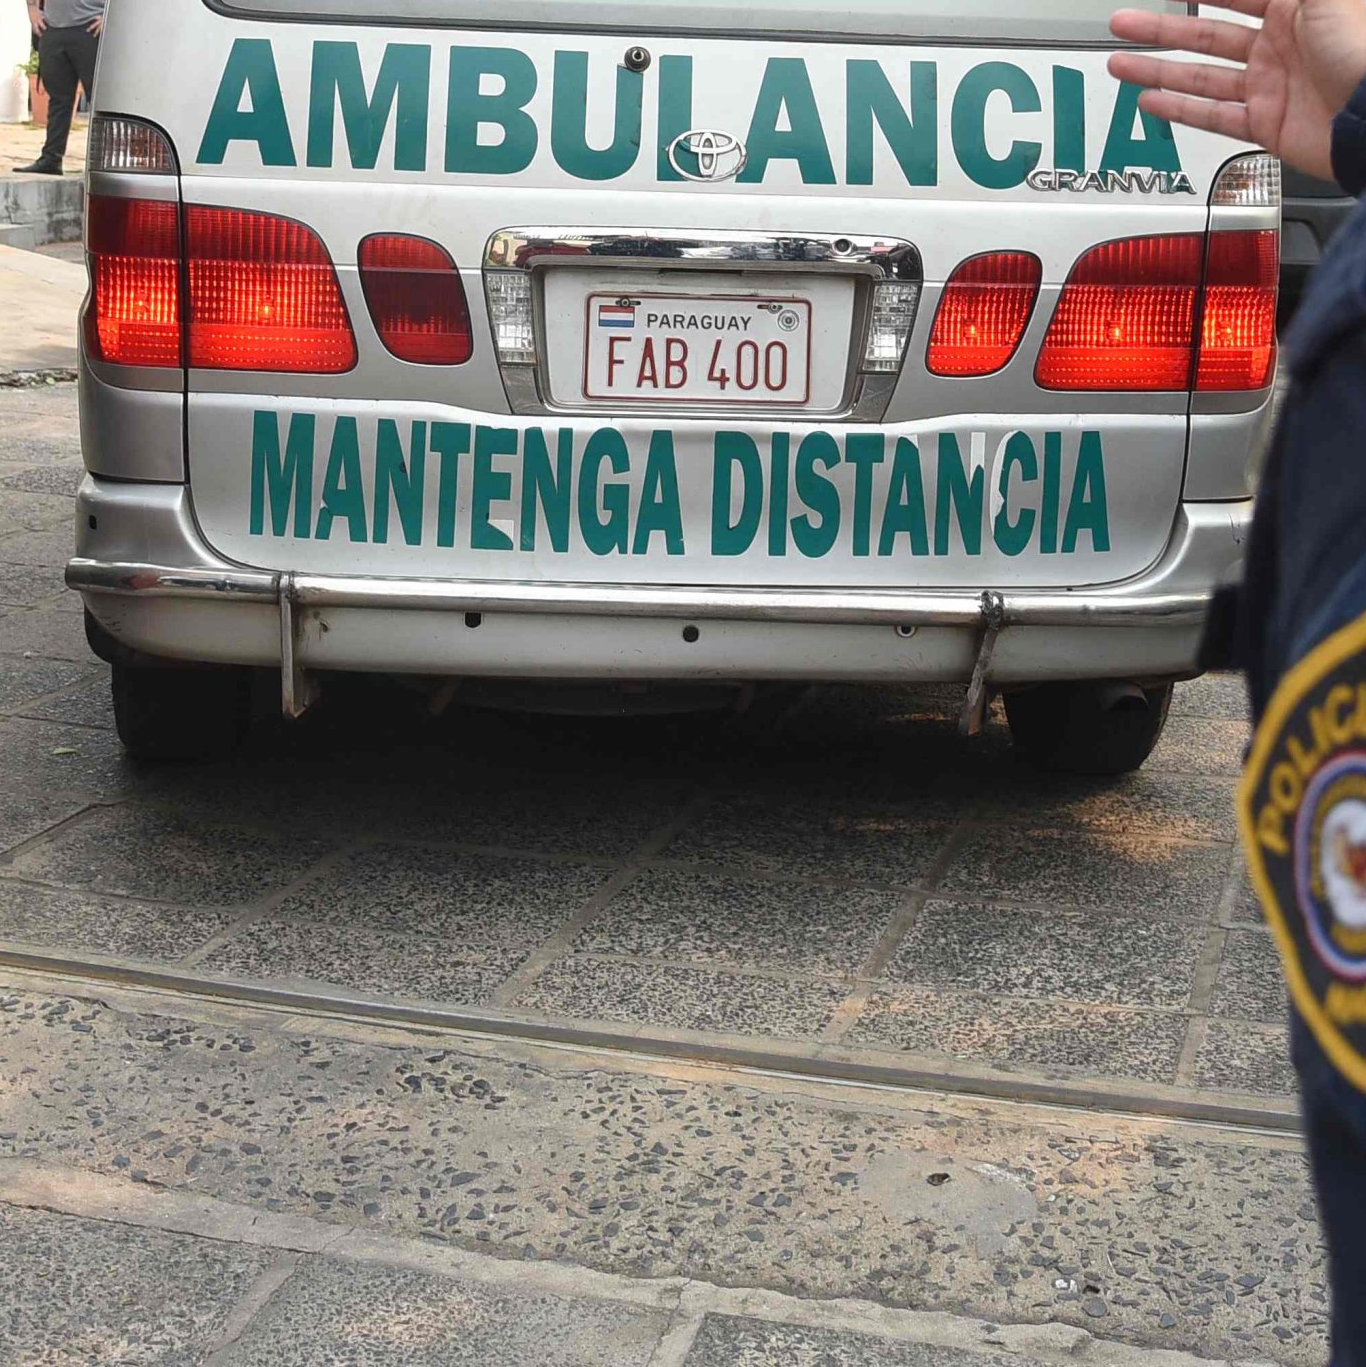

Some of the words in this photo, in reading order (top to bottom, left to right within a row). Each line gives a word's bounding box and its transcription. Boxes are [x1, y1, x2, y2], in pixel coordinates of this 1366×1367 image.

[196, 38, 1183, 191] AMBULANCIA
[1026, 168, 1197, 195] GRANVIA
[646, 313, 752, 332] PARAGUAY
[607, 336, 688, 390] FAB
[707, 338, 788, 392] 400
[250, 410, 684, 556] MANTENGA
[711, 429, 1112, 559] DISTANCIA
